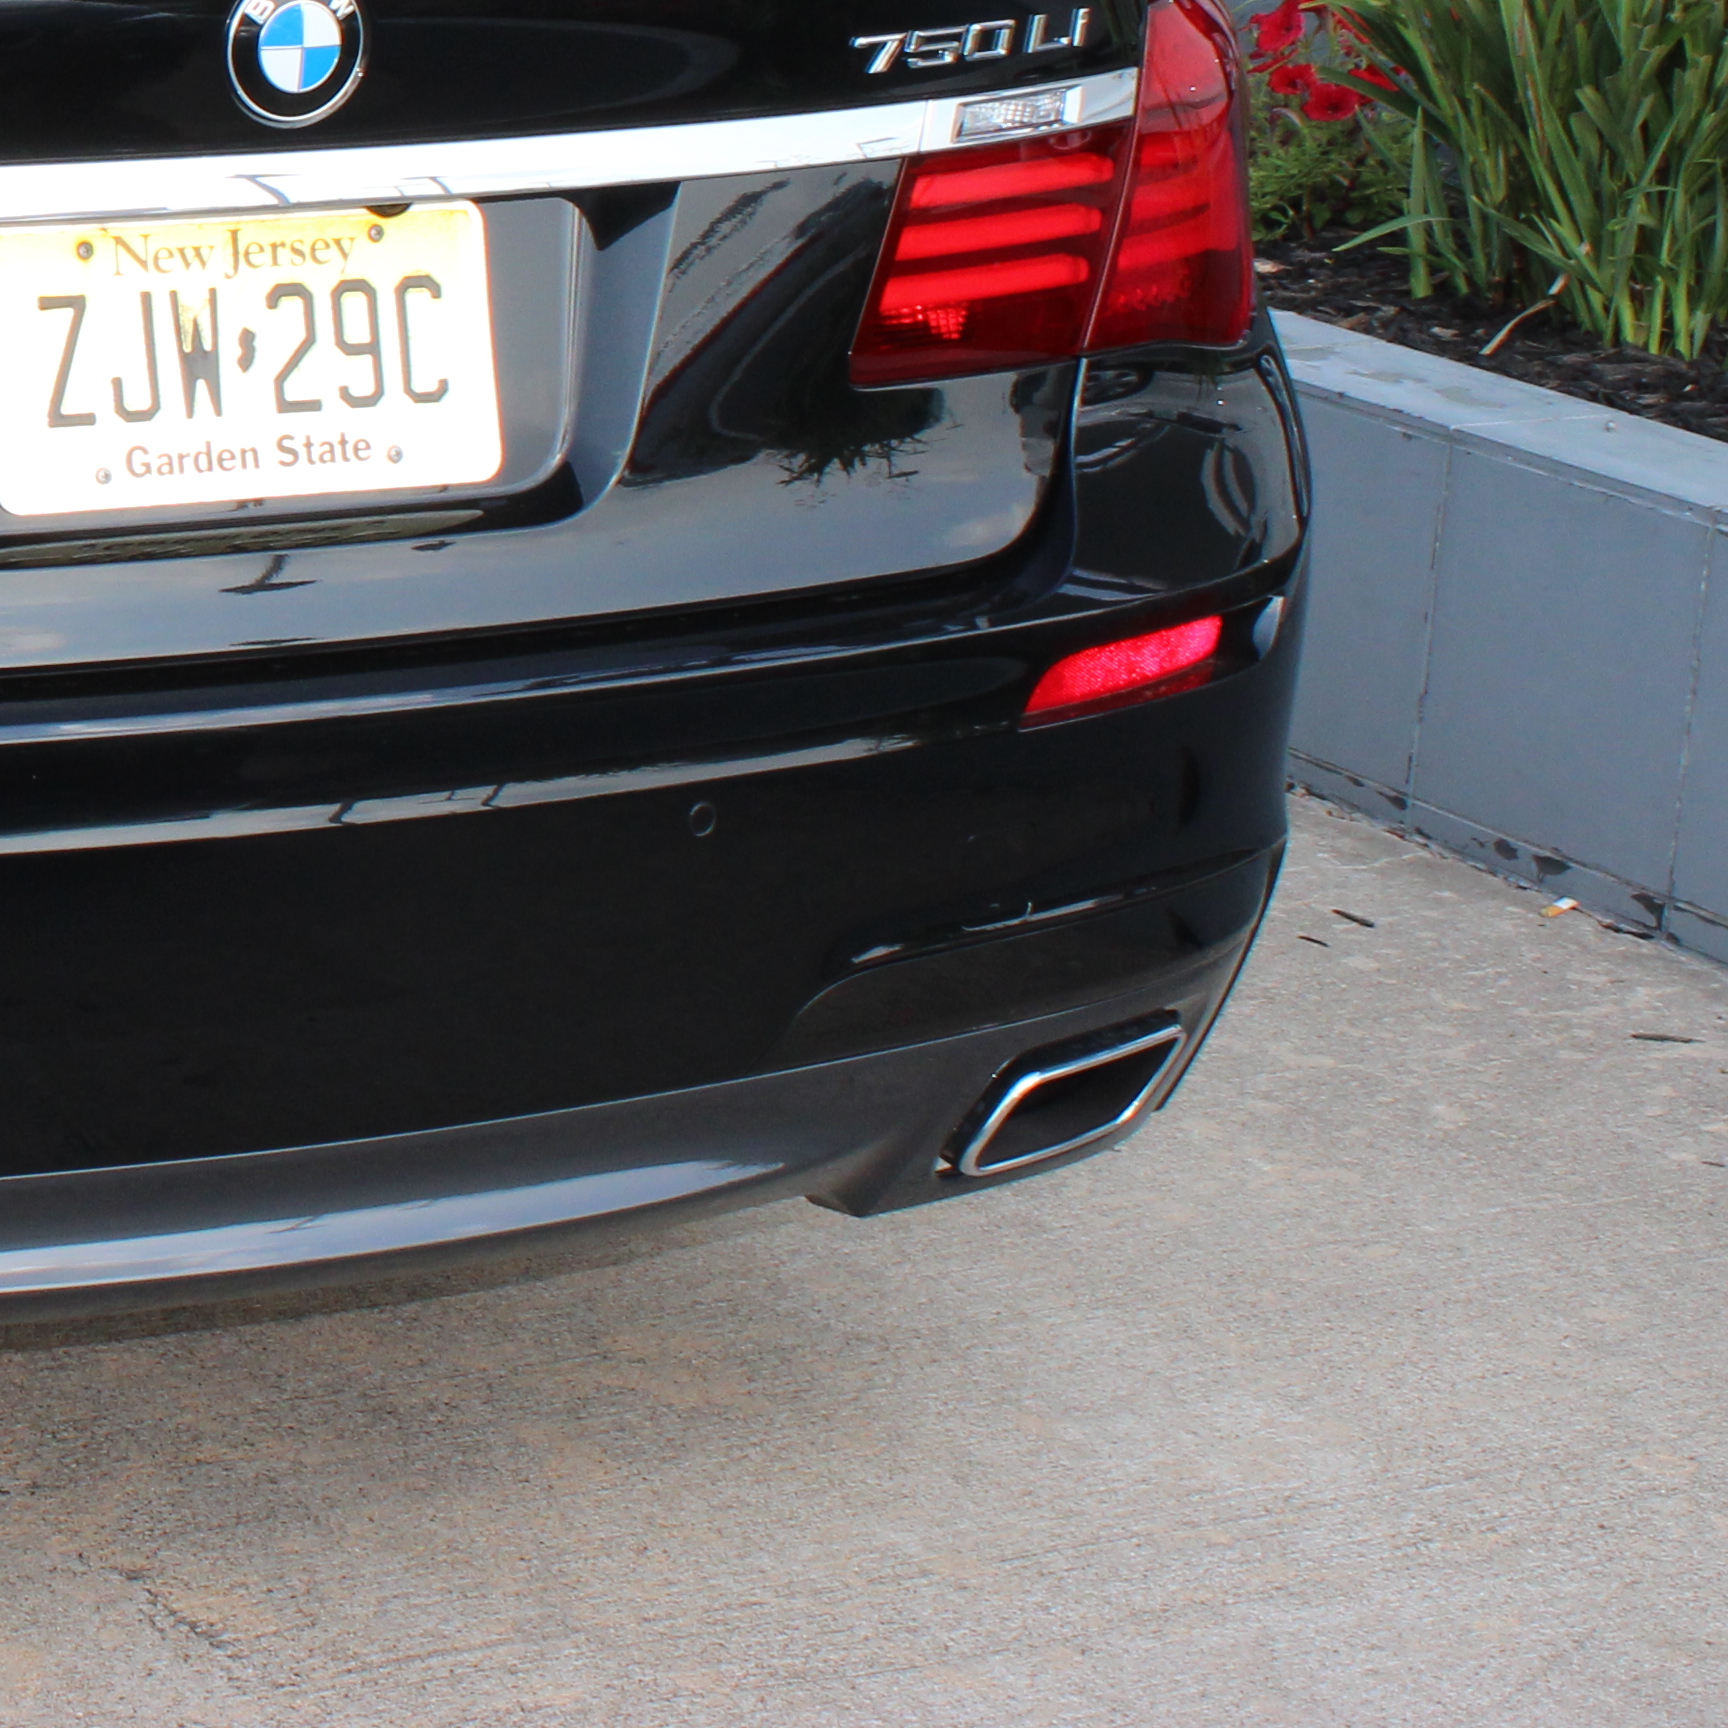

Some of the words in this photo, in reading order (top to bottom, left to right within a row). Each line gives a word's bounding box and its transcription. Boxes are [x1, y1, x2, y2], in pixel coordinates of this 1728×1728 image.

[111, 233, 215, 277] New
[223, 228, 357, 280] Jersey
[125, 439, 260, 477] Garden
[276, 431, 373, 468] State
